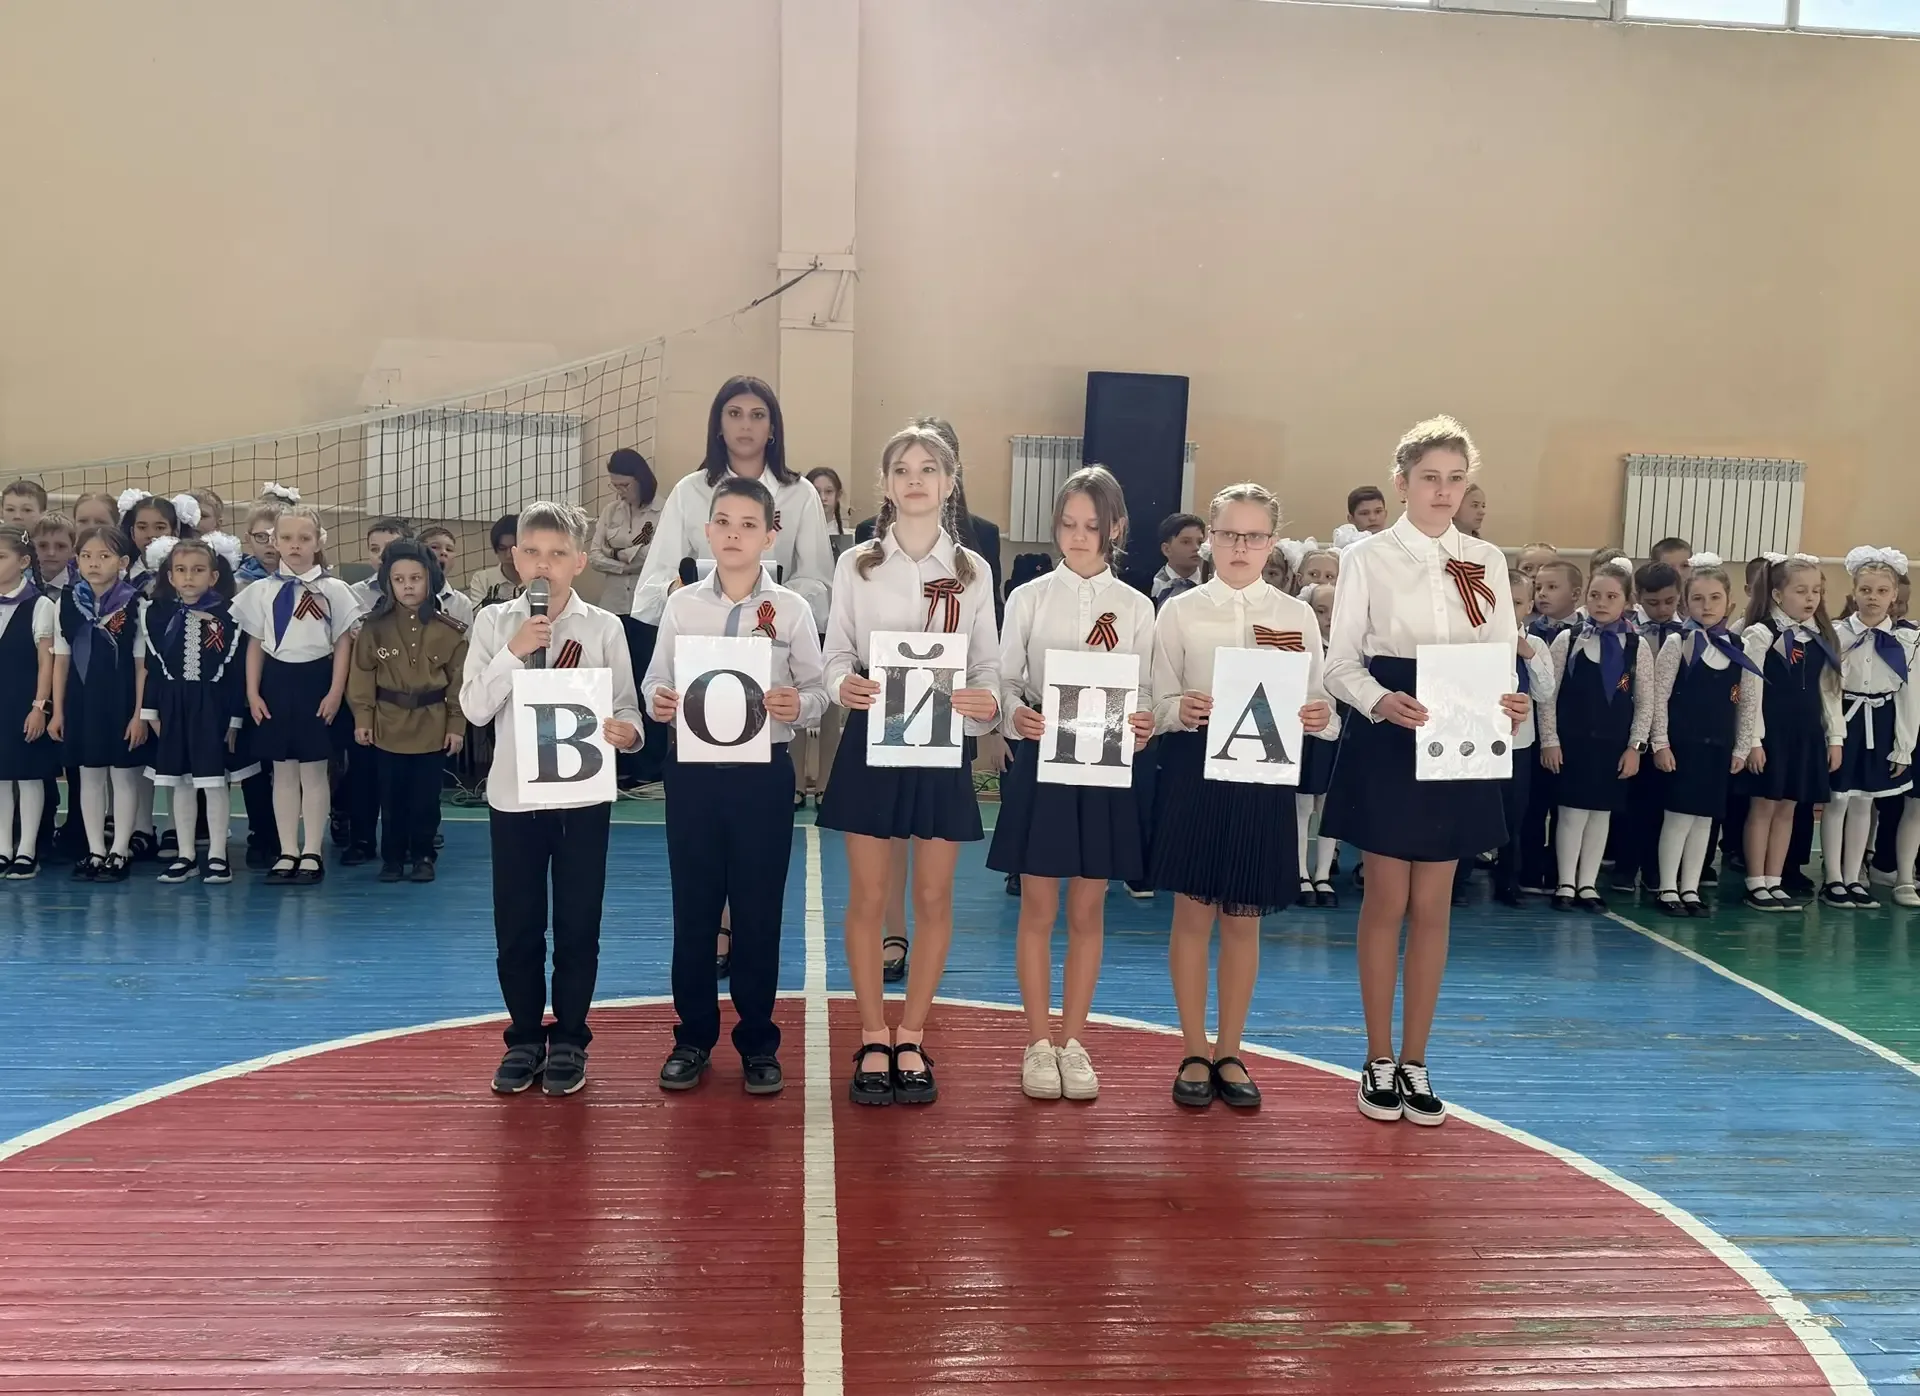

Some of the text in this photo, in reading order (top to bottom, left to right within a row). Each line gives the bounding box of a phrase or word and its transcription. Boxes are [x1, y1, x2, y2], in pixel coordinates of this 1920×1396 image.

[683, 669, 767, 747] О
[872, 641, 965, 747] Й
[1044, 684, 1137, 767] Н
[1211, 682, 1296, 764] А
[524, 703, 603, 783] В
